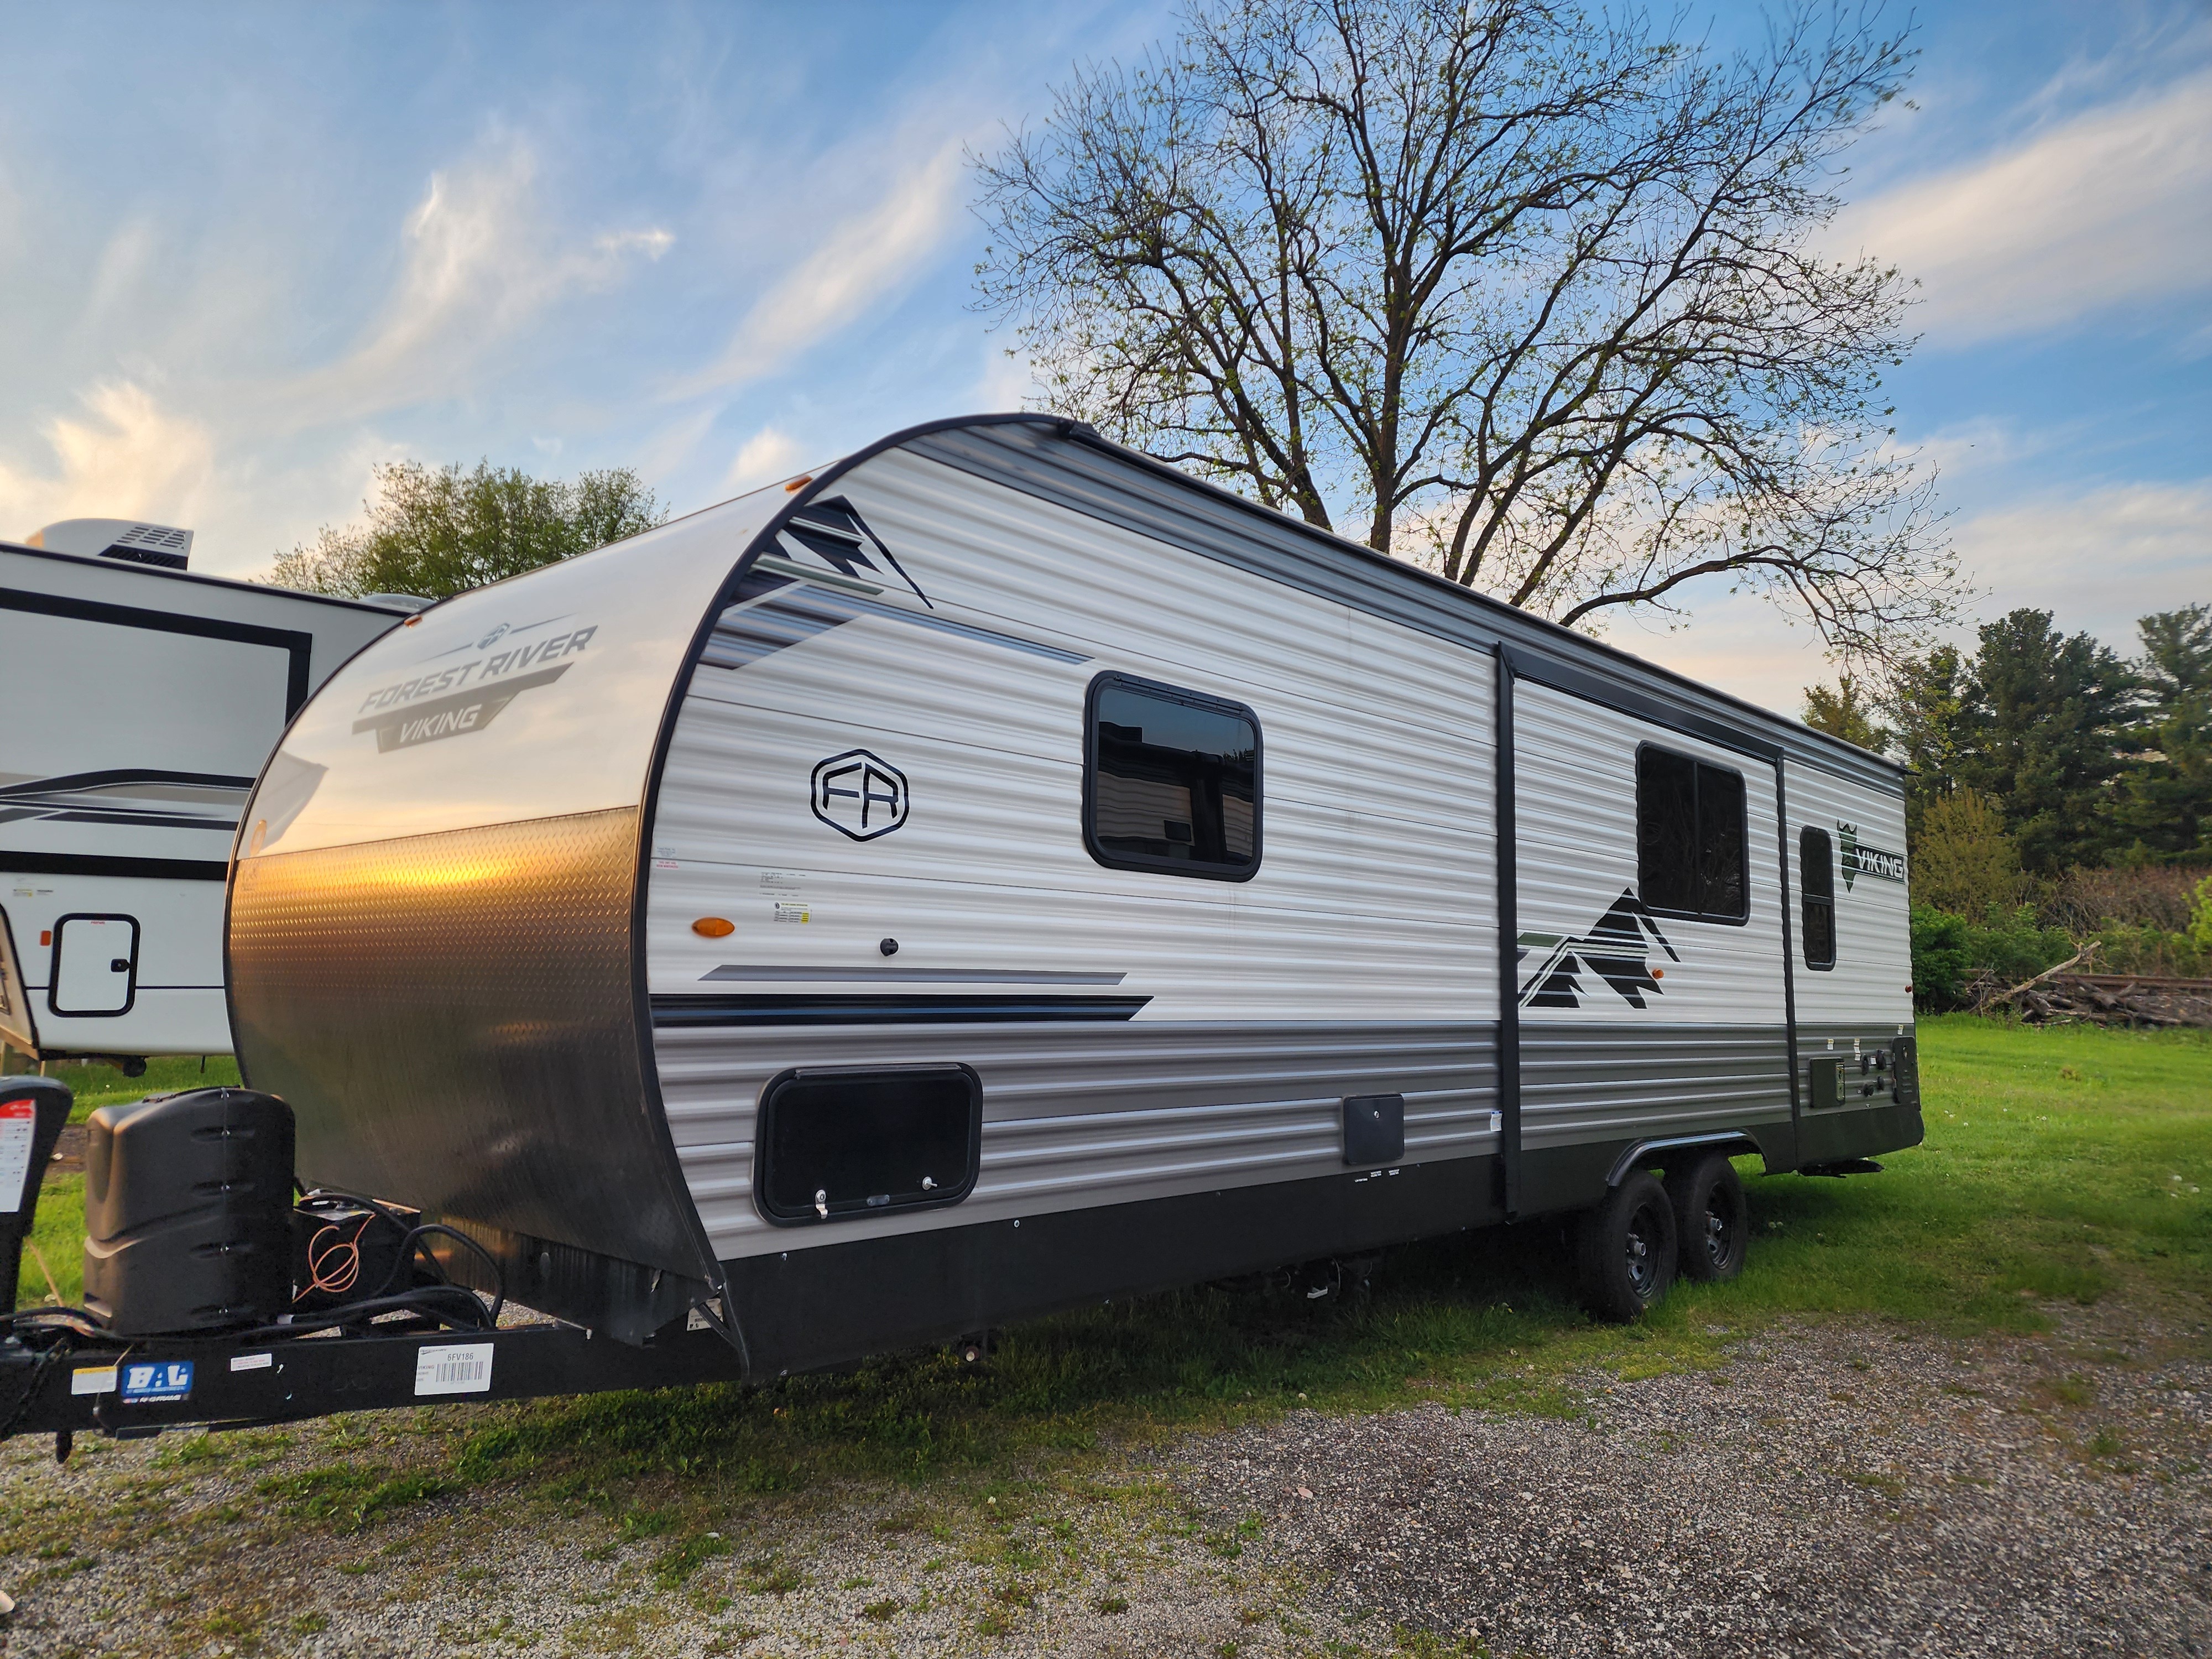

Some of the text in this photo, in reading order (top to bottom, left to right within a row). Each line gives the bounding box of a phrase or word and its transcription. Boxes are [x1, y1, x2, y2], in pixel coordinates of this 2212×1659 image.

[358, 625, 598, 713] FOREST RIVER
[399, 704, 482, 743] VIKING
[1855, 847, 1904, 879] VIKING
[447, 1353, 473, 1361] 6FV186
